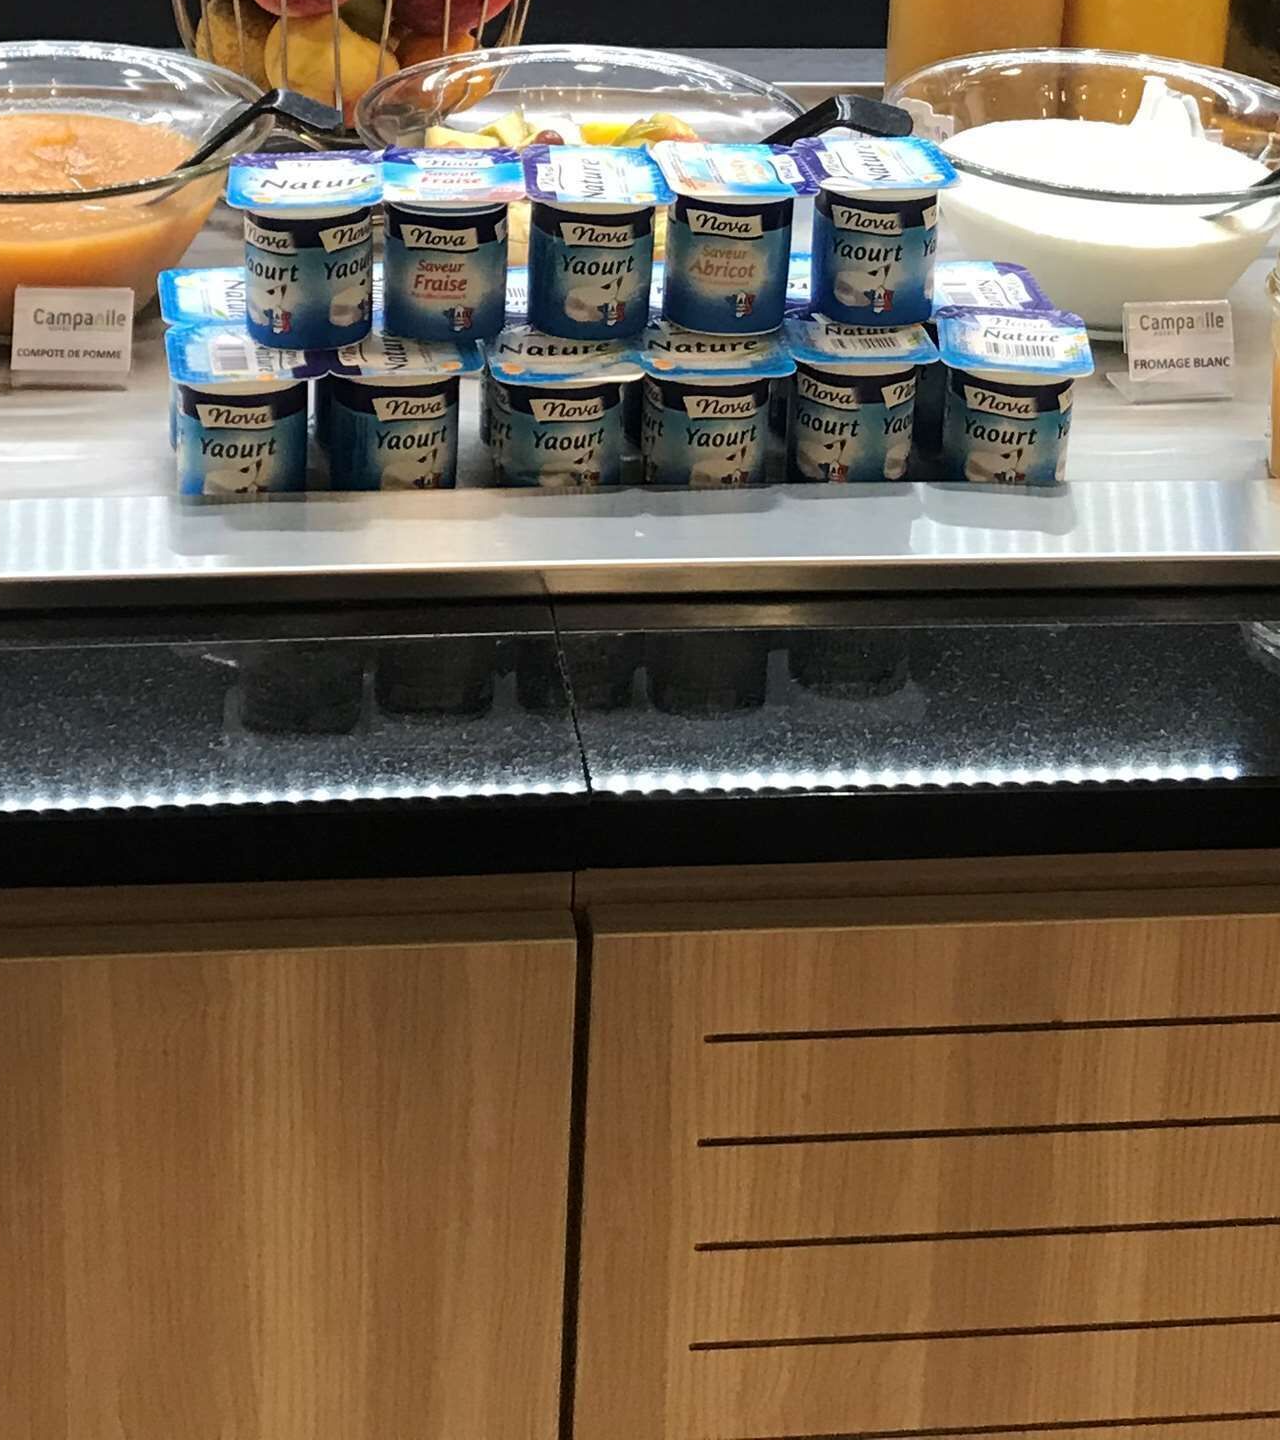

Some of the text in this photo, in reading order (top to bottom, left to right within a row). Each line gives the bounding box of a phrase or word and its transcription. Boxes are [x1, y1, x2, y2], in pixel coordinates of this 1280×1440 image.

[260, 171, 377, 191] Nature
[581, 158, 607, 201] Nature
[695, 213, 752, 235] Nova
[840, 209, 898, 232] Nova
[410, 227, 467, 247] Nova
[572, 225, 629, 244] Nova
[702, 244, 748, 260] Saveur
[831, 234, 904, 263] Yaourt
[416, 260, 465, 274] Saveur
[561, 253, 635, 276] Yaourt
[687, 259, 757, 279] Abricot
[413, 274, 468, 292] Fraise
[983, 328, 1060, 343] Nature
[16, 348, 122, 359] COMPOTE DE POMME
[499, 340, 611, 358] Nature
[647, 338, 759, 354] Nature
[1133, 356, 1232, 370] FROMAGE BLANC
[801, 377, 855, 405] Nova
[385, 397, 443, 418] Nova
[543, 401, 601, 418] Nova
[696, 398, 753, 415] Nova
[973, 390, 1033, 415] Nova
[208, 407, 267, 425] Nova
[375, 425, 447, 450] Yaourt
[532, 427, 606, 451] Yaourt
[685, 424, 757, 448] Yaourt
[964, 415, 1038, 445] Yaourt
[200, 436, 277, 459] Yaourt
